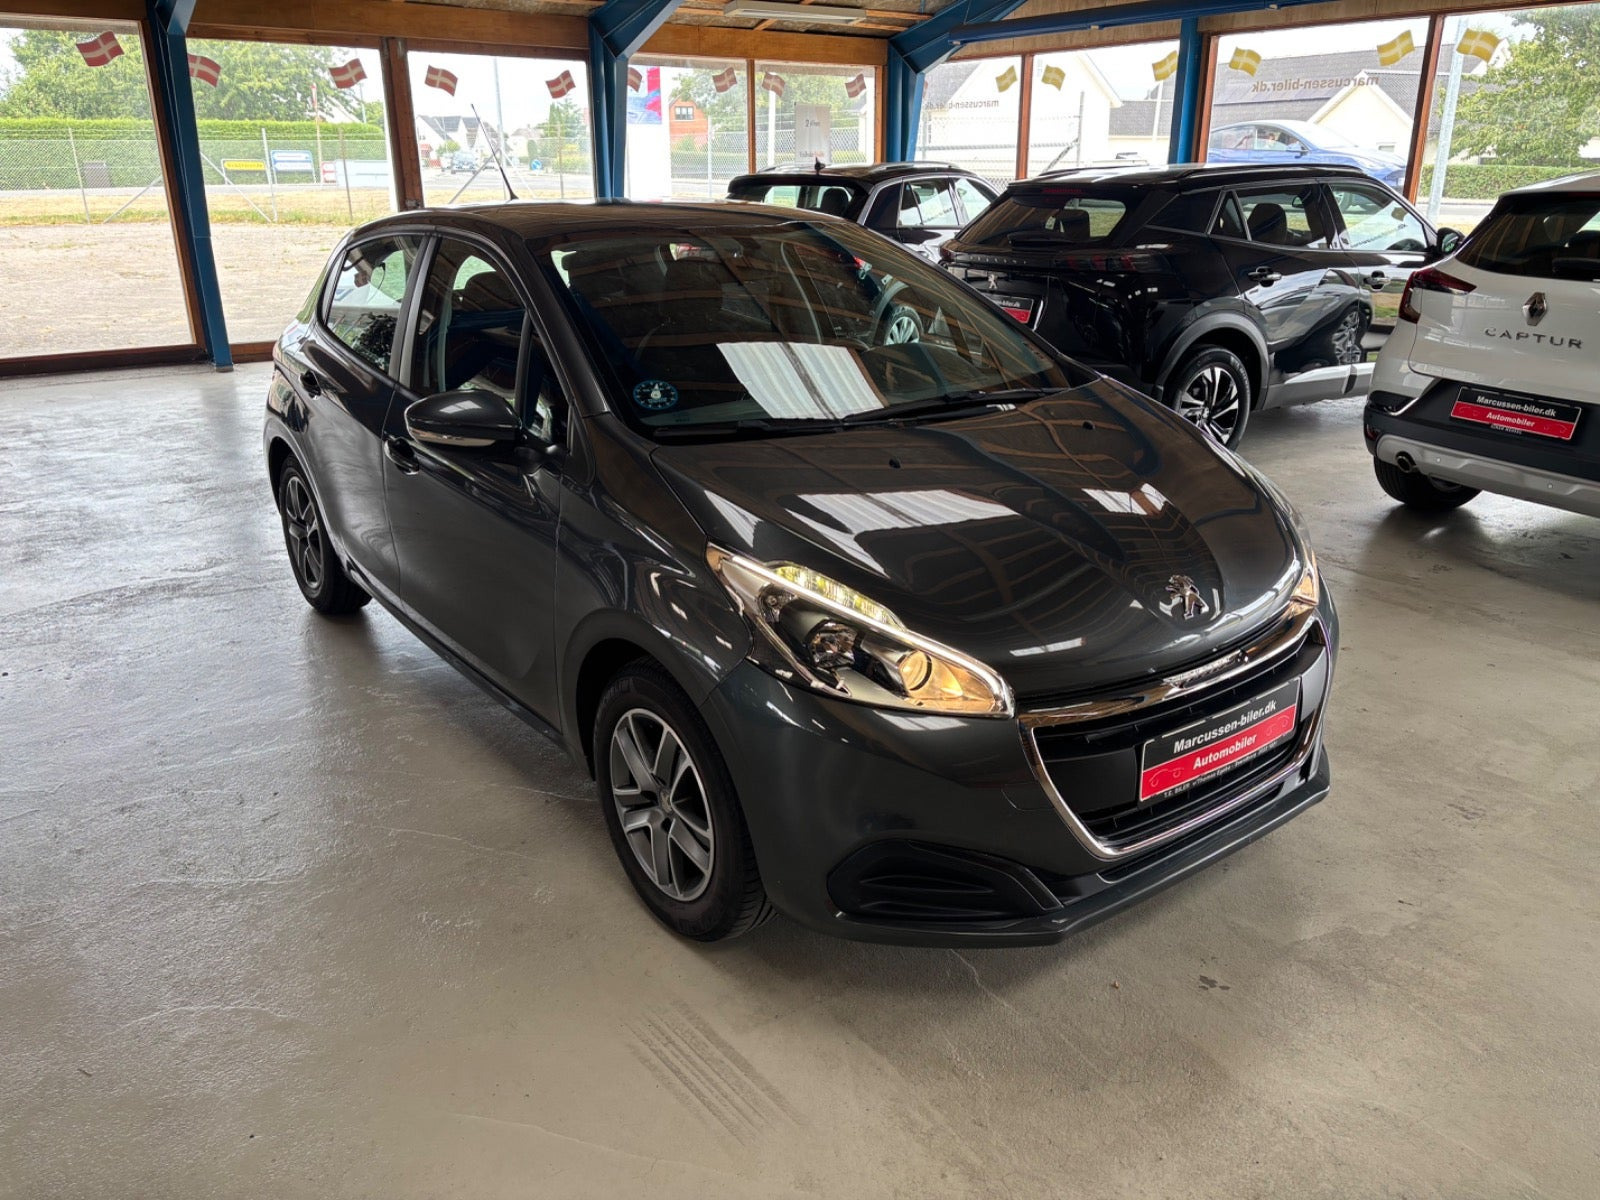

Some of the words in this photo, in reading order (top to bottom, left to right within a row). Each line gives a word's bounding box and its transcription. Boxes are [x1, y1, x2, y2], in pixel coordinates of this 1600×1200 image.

[1485, 328, 1584, 349] CAPTUR
[1476, 395, 1557, 417] Marcussen-biler.dk
[1486, 411, 1536, 428] Automobiler
[1173, 700, 1277, 754] Marcussen-biler.dk
[1193, 734, 1258, 770] Automobiler
